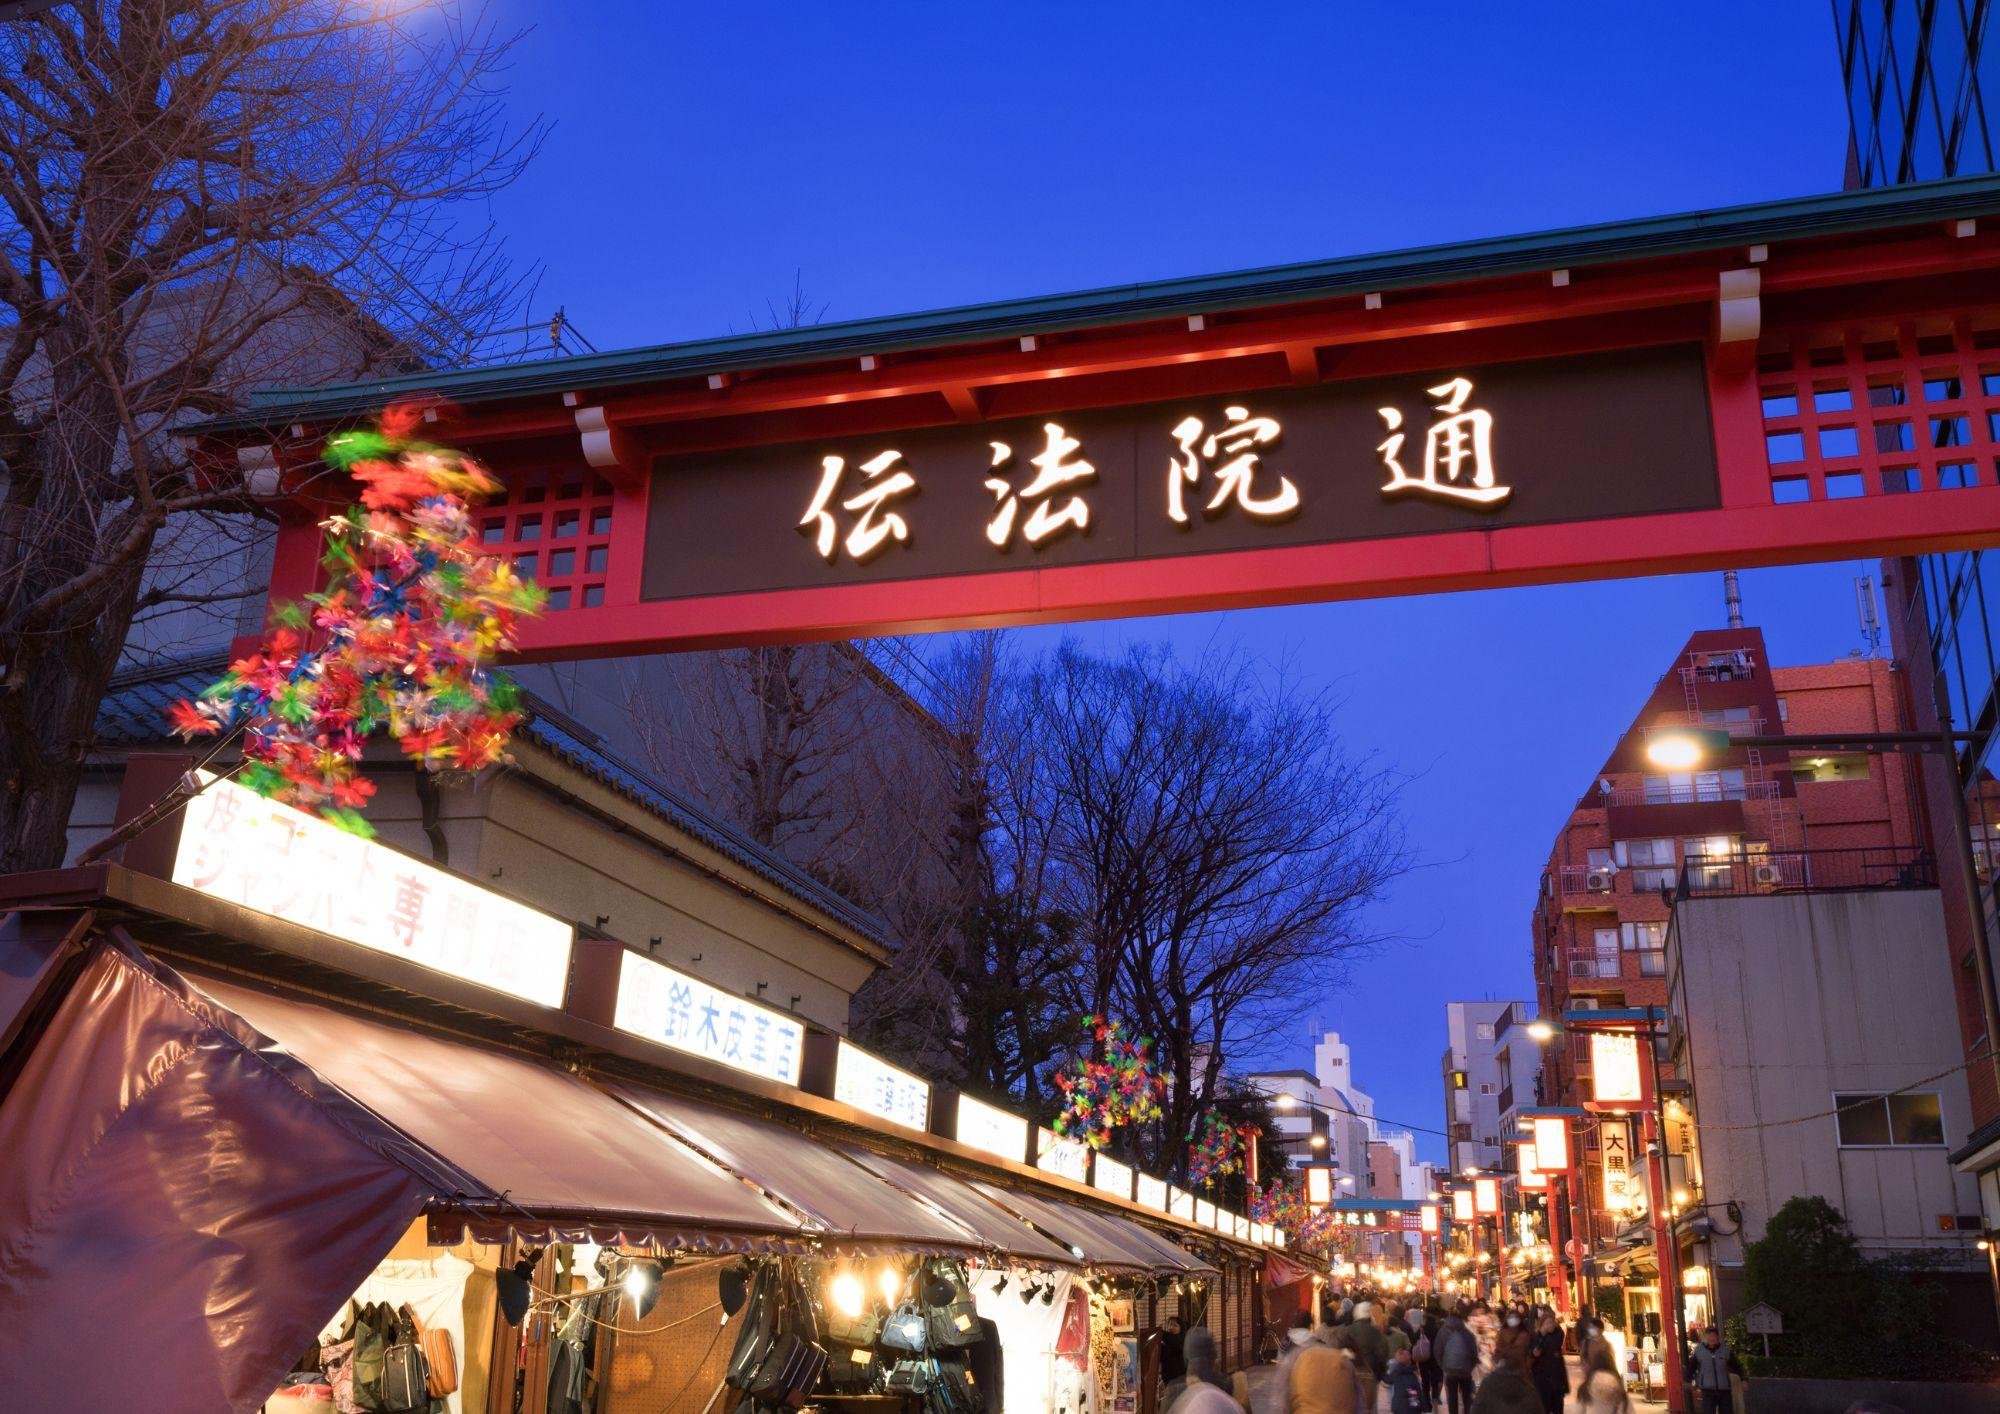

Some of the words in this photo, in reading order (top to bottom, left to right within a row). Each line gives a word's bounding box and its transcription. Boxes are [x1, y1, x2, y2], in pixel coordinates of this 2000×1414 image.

[799, 377, 1511, 558] 伝法院通
[1605, 1133, 1628, 1197] 大黒家
